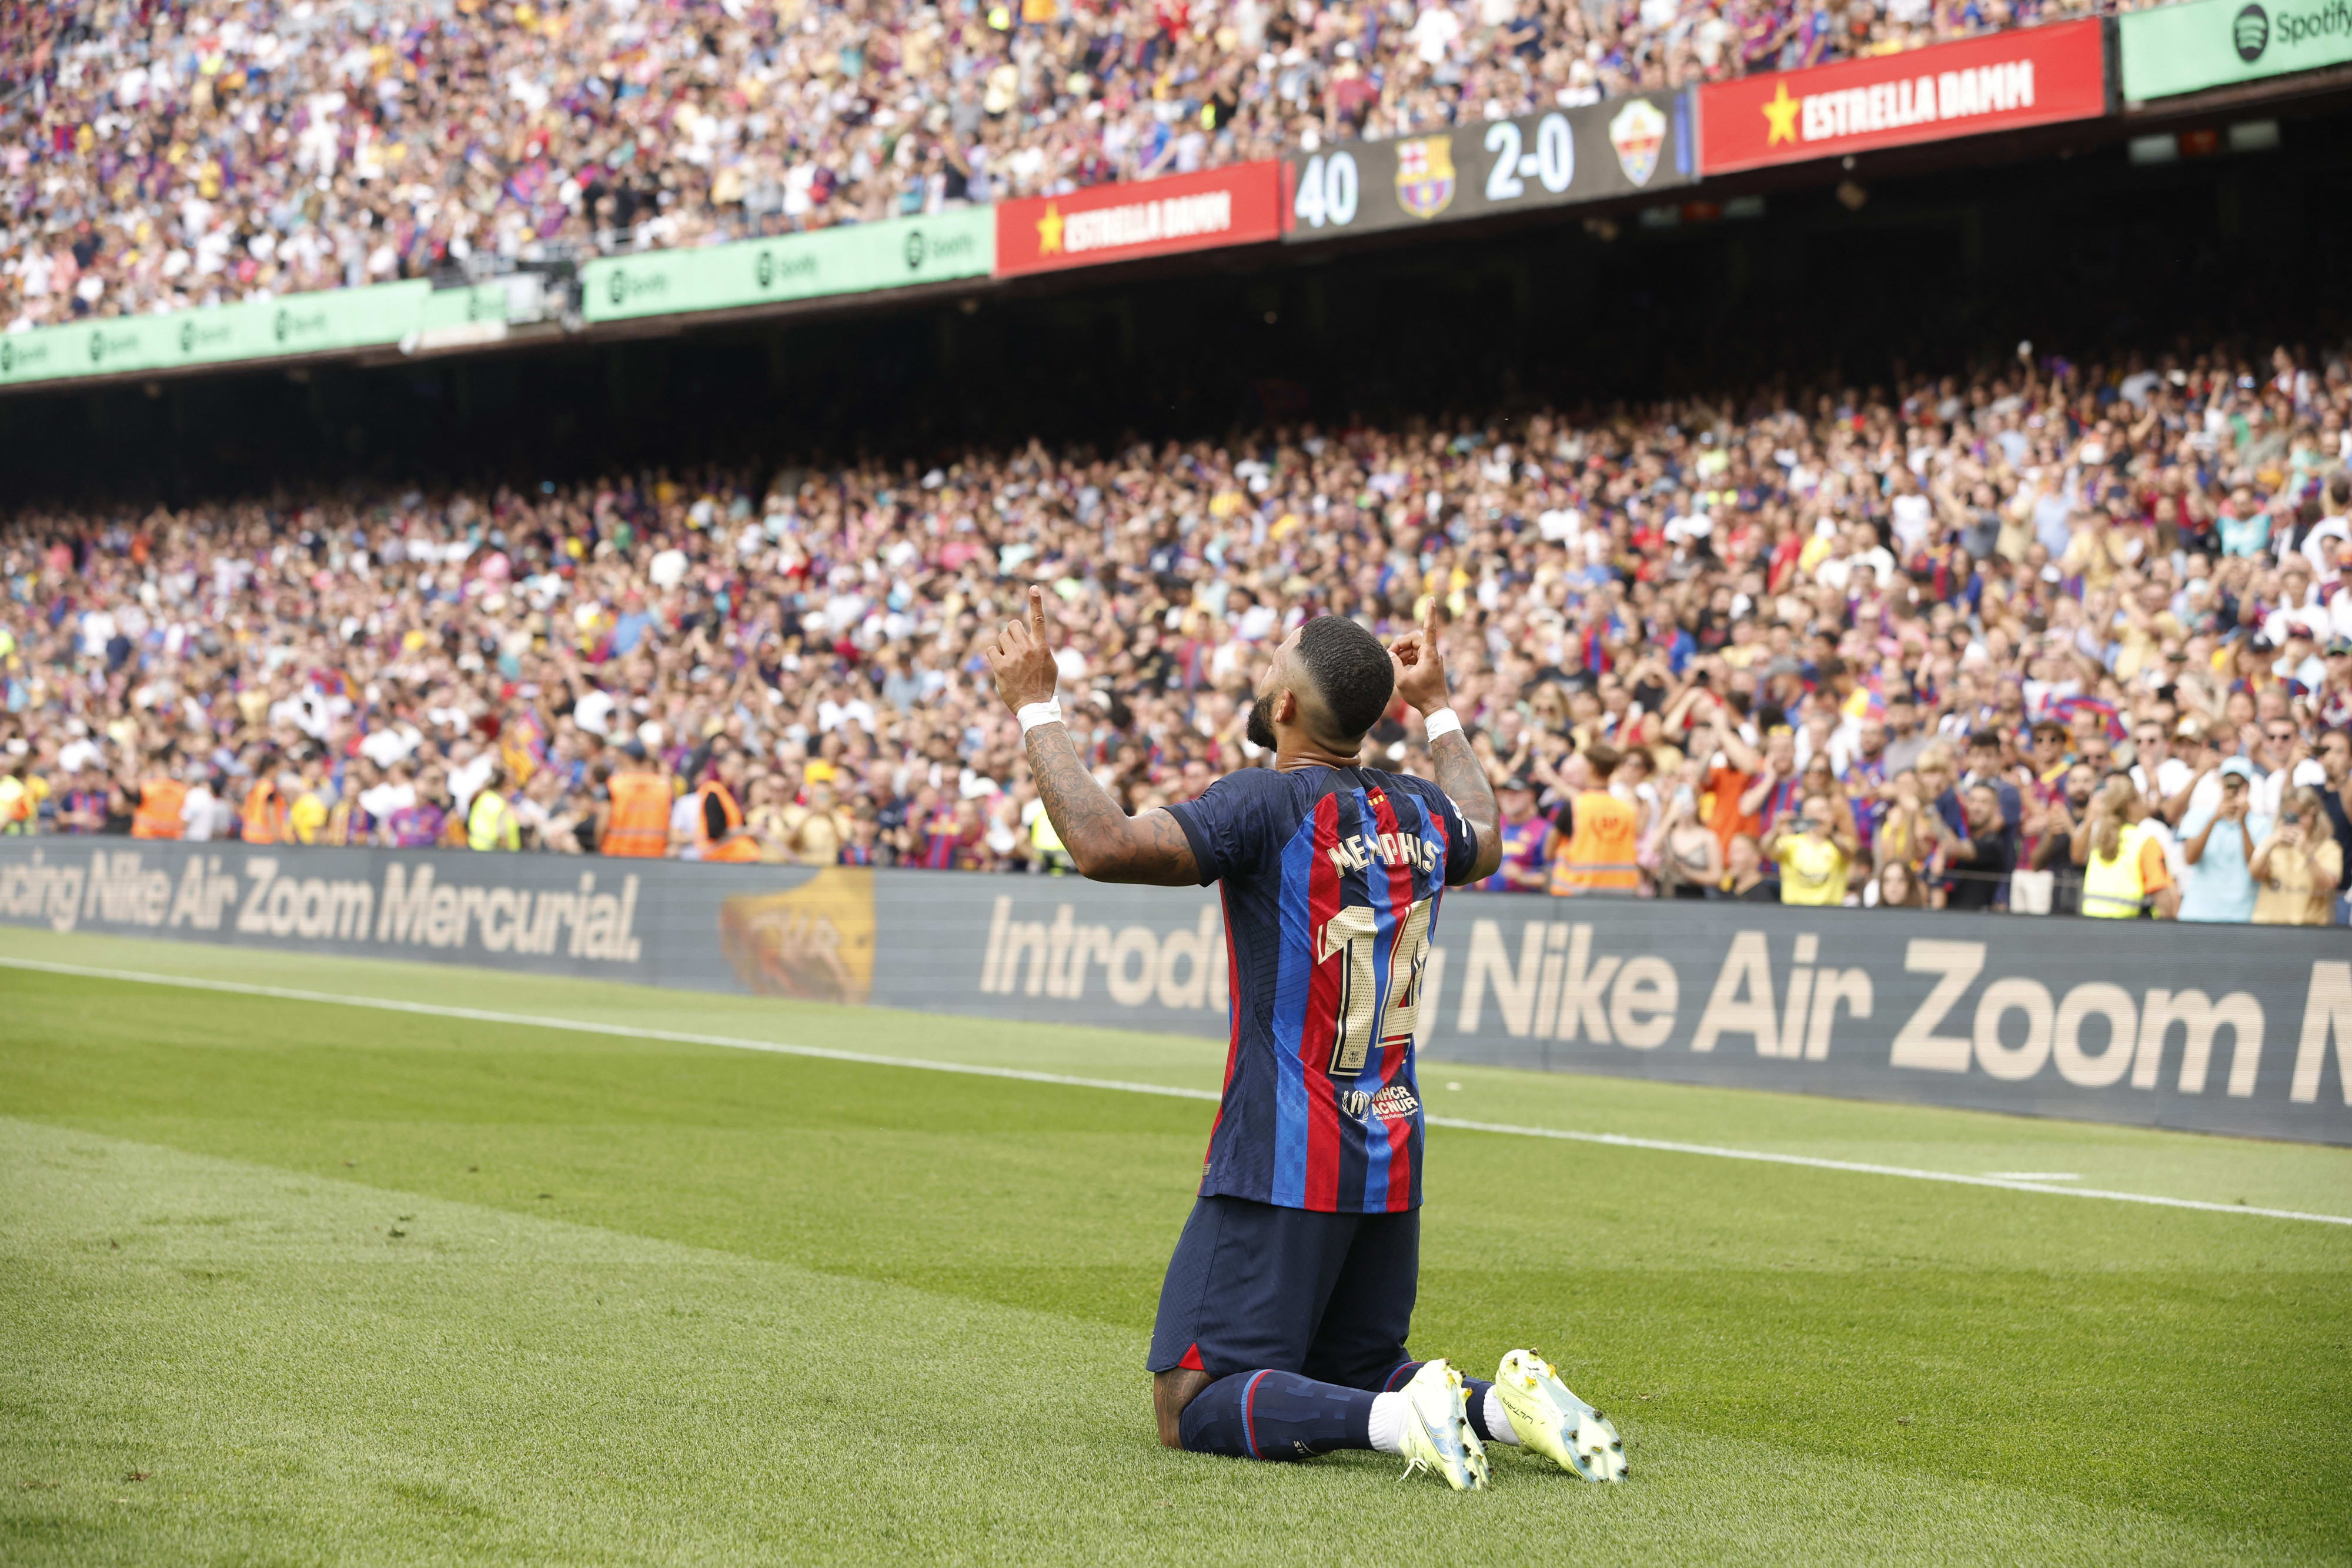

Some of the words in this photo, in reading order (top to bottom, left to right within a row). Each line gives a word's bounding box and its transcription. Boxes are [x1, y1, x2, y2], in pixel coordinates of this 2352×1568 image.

[1802, 75, 1938, 142] ESTRELLA
[1937, 58, 2036, 120] DAMM
[1294, 151, 1359, 228] 40
[1484, 112, 1575, 201] 2-0
[1327, 833, 1439, 878] MEMPHIS
[85, 848, 171, 927] Nike
[169, 854, 238, 931] Air
[236, 856, 375, 942] Zoom
[375, 861, 642, 963] Mercurial.
[1317, 897, 1432, 1076] 14
[1457, 918, 1680, 1051] Nike
[1690, 928, 1875, 1062] Air
[1889, 938, 2267, 1098] Zoom
[1371, 1096, 1419, 1116] ACNUR
[1502, 1397, 1534, 1425] ULTRA
